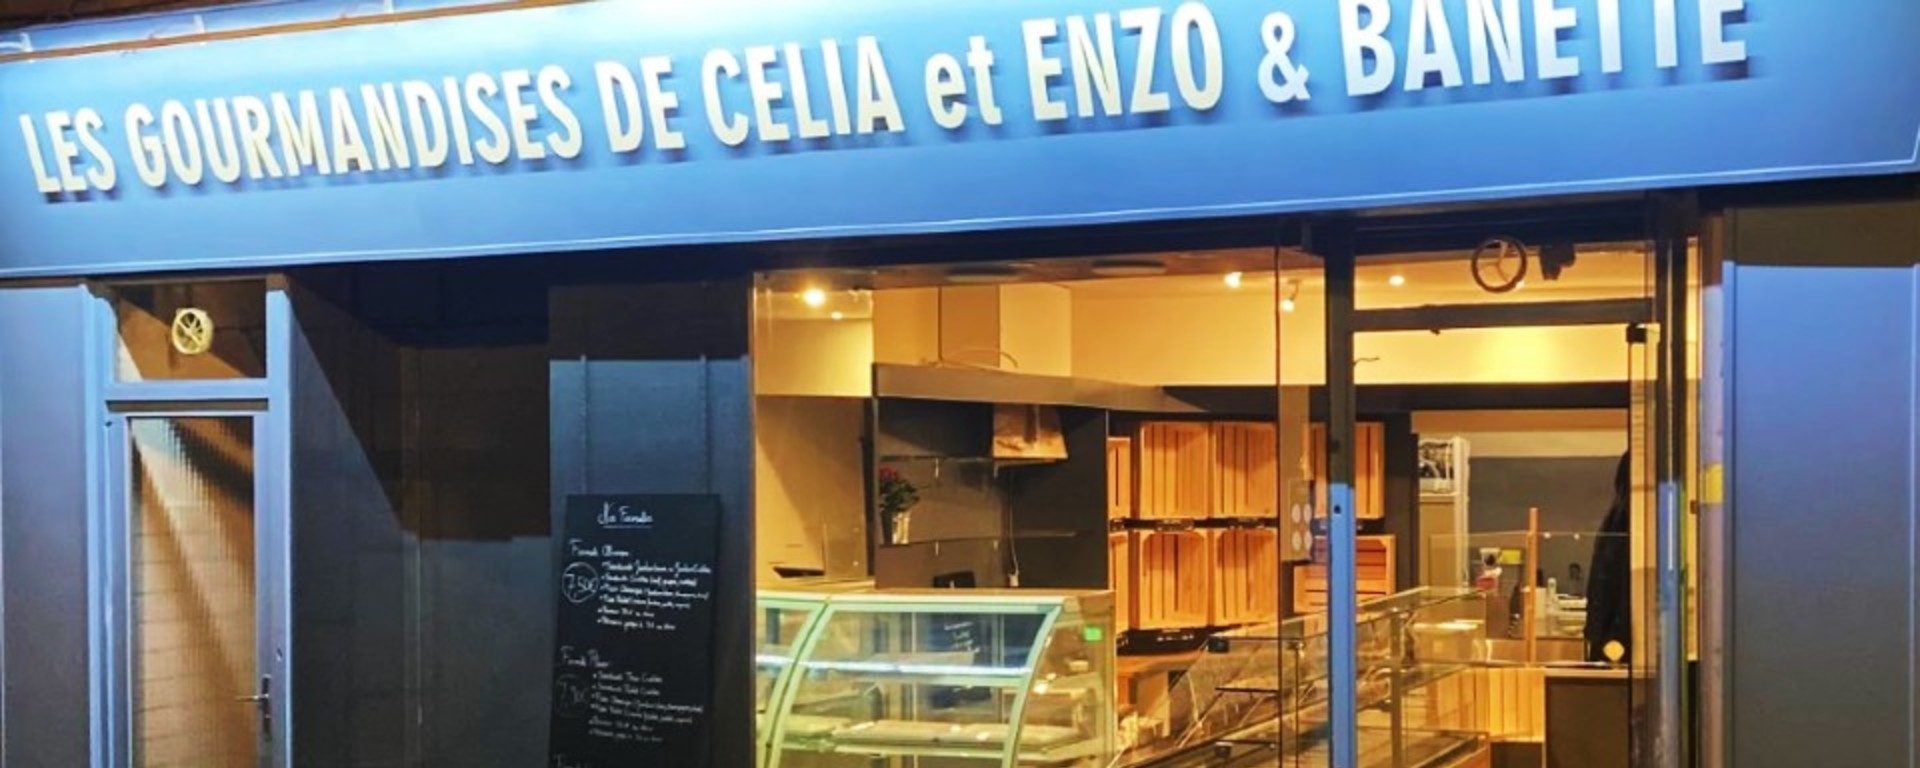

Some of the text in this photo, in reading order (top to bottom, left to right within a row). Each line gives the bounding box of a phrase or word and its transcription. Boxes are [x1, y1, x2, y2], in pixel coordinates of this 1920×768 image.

[20, 0, 1748, 194] LES GOURMANDISES DE CELIA et ENZO & BANETTE
